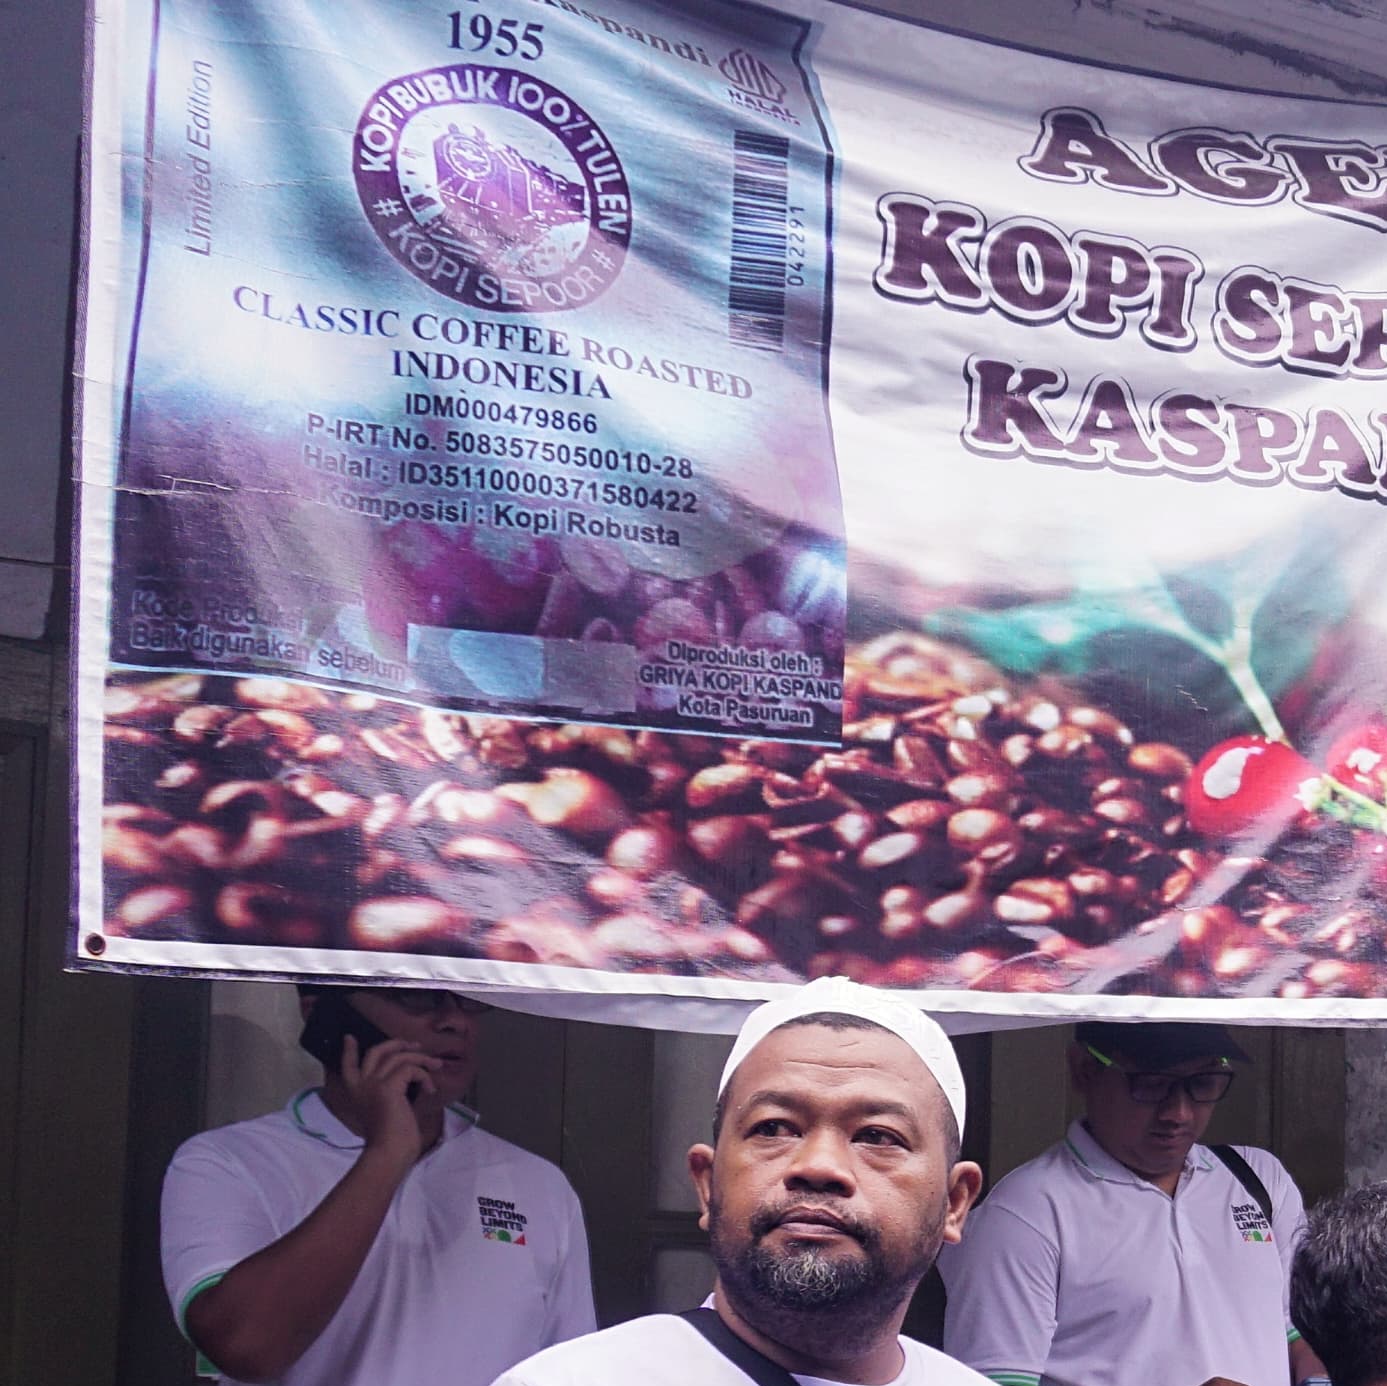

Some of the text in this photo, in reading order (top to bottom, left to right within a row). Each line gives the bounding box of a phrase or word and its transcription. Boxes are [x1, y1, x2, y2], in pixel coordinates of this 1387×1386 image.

[447, 10, 544, 61] 1955
[540, 0, 712, 67] aspandi
[727, 88, 798, 119] HALAL
[184, 60, 214, 257] Limited Edition
[360, 96, 404, 173] KOPI
[393, 69, 499, 114] BUBUK
[576, 129, 628, 234] TULEN
[389, 222, 470, 293] KOPI
[474, 265, 604, 306] SEPOOR
[786, 206, 806, 287] 042291
[875, 192, 1205, 351] KOPI
[233, 286, 754, 400] CLASSIC COFFEE ROASTED
[392, 350, 613, 400] INDONESIA
[405, 392, 598, 434] IDM000479866
[307, 413, 694, 480] P-IRT No. 5083575050010-28
[303, 444, 372, 479] Halal
[400, 461, 698, 514] ID35110000371580422
[328, 483, 468, 523] Komposisi
[494, 503, 558, 535] Kopi
[566, 511, 680, 547] Robusta
[131, 621, 188, 649] Baik
[190, 624, 311, 659] digunakan
[667, 641, 765, 669] Diproduksi
[770, 652, 808, 673] oleh
[639, 665, 698, 688] GRIYA
[703, 671, 750, 693] KOPI
[678, 694, 812, 724] Kota Pasuruan
[477, 1196, 515, 1211] GROW
[479, 1206, 528, 1225] BEYOND
[480, 1216, 524, 1232] LIMITS
[1236, 1220, 1269, 1230] LIMITS
